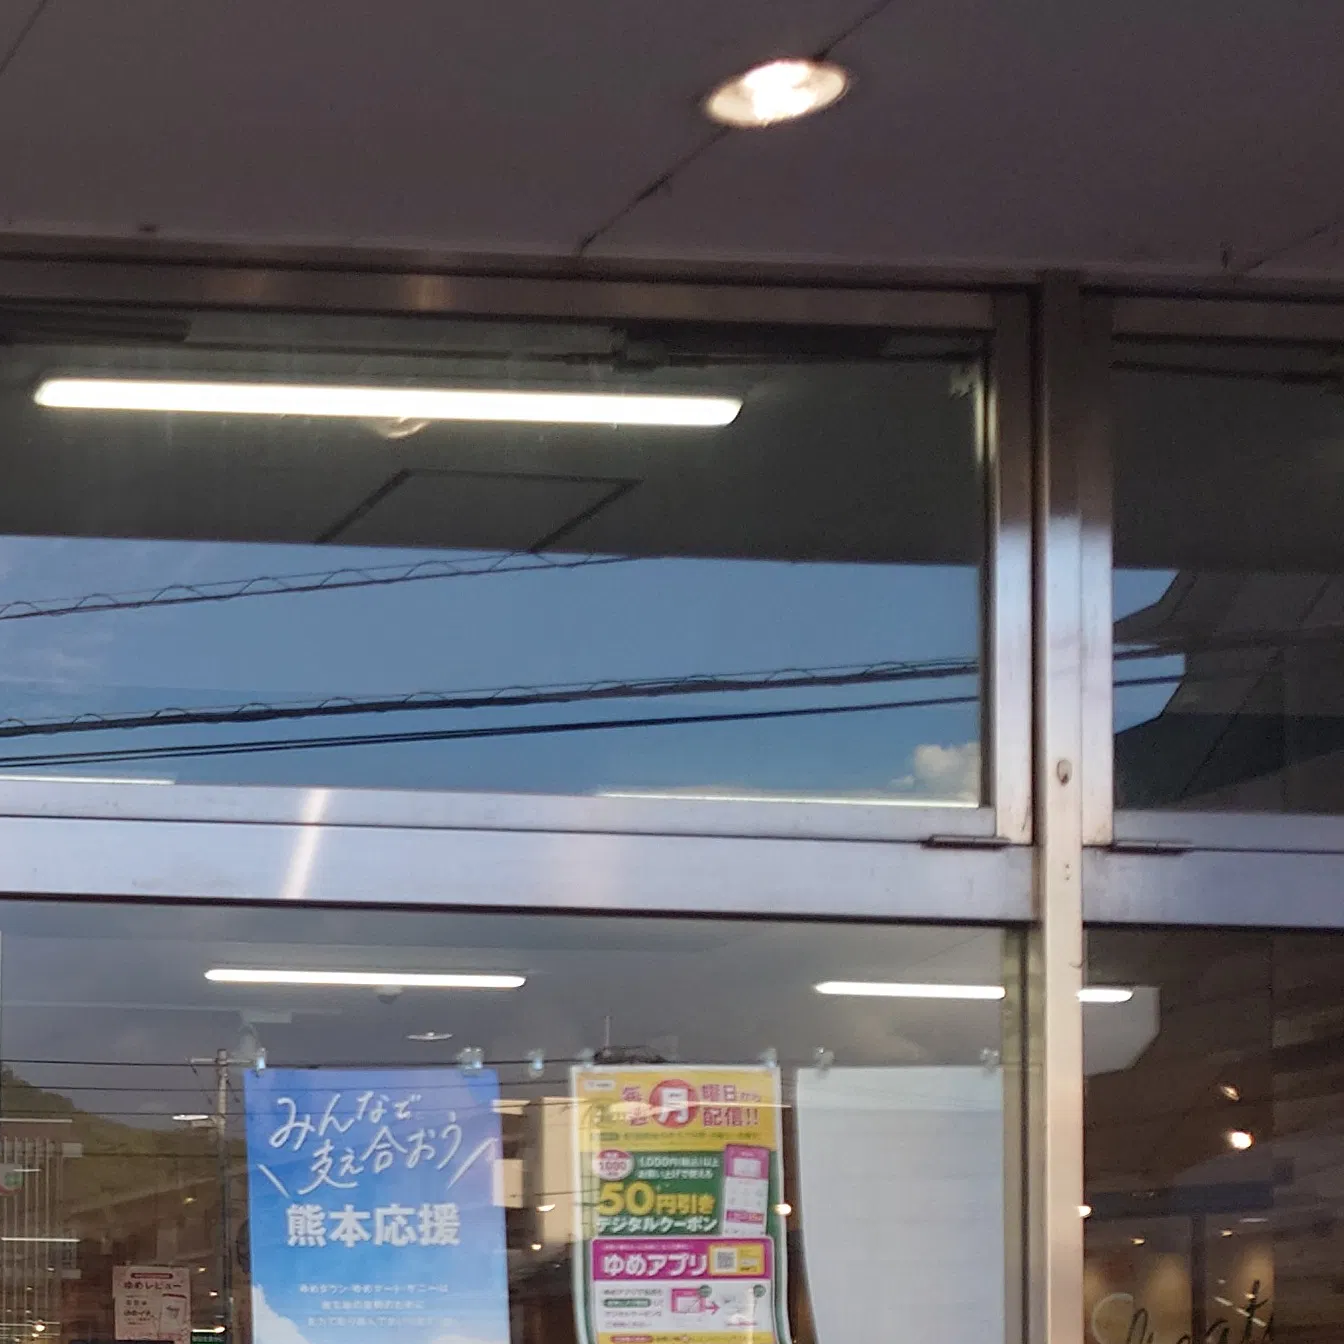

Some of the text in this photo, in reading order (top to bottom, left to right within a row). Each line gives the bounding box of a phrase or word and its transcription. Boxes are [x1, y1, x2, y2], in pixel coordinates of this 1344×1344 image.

[269, 1089, 421, 1151] みんなで
[659, 1087, 689, 1123] 月
[286, 1203, 461, 1248] 熊本応援
[603, 1253, 708, 1277] ゆめアプリ
